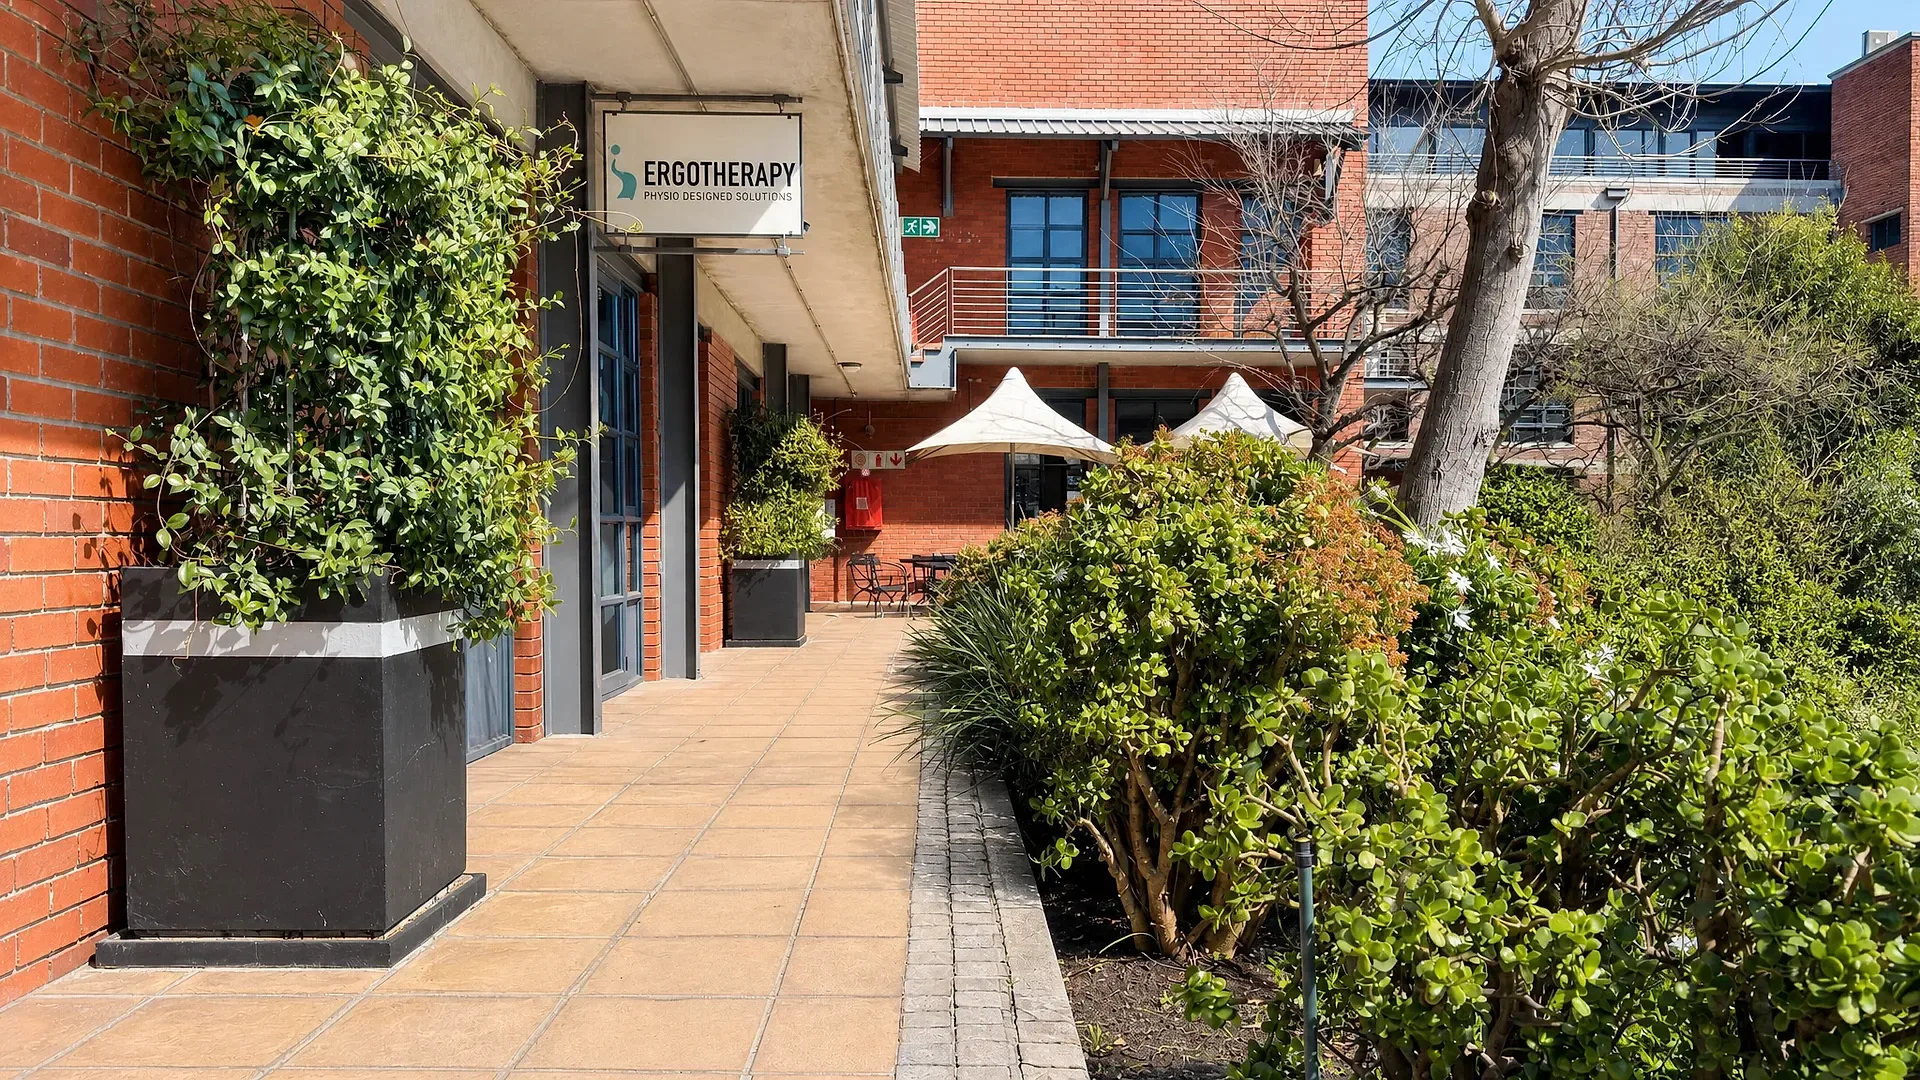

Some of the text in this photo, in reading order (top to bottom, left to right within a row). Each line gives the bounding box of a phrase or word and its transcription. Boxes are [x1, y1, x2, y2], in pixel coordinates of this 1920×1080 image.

[644, 160, 796, 187] ERGOTHERAPY
[644, 191, 793, 201] PHYSIO DESIGNED SOLUTIONS
